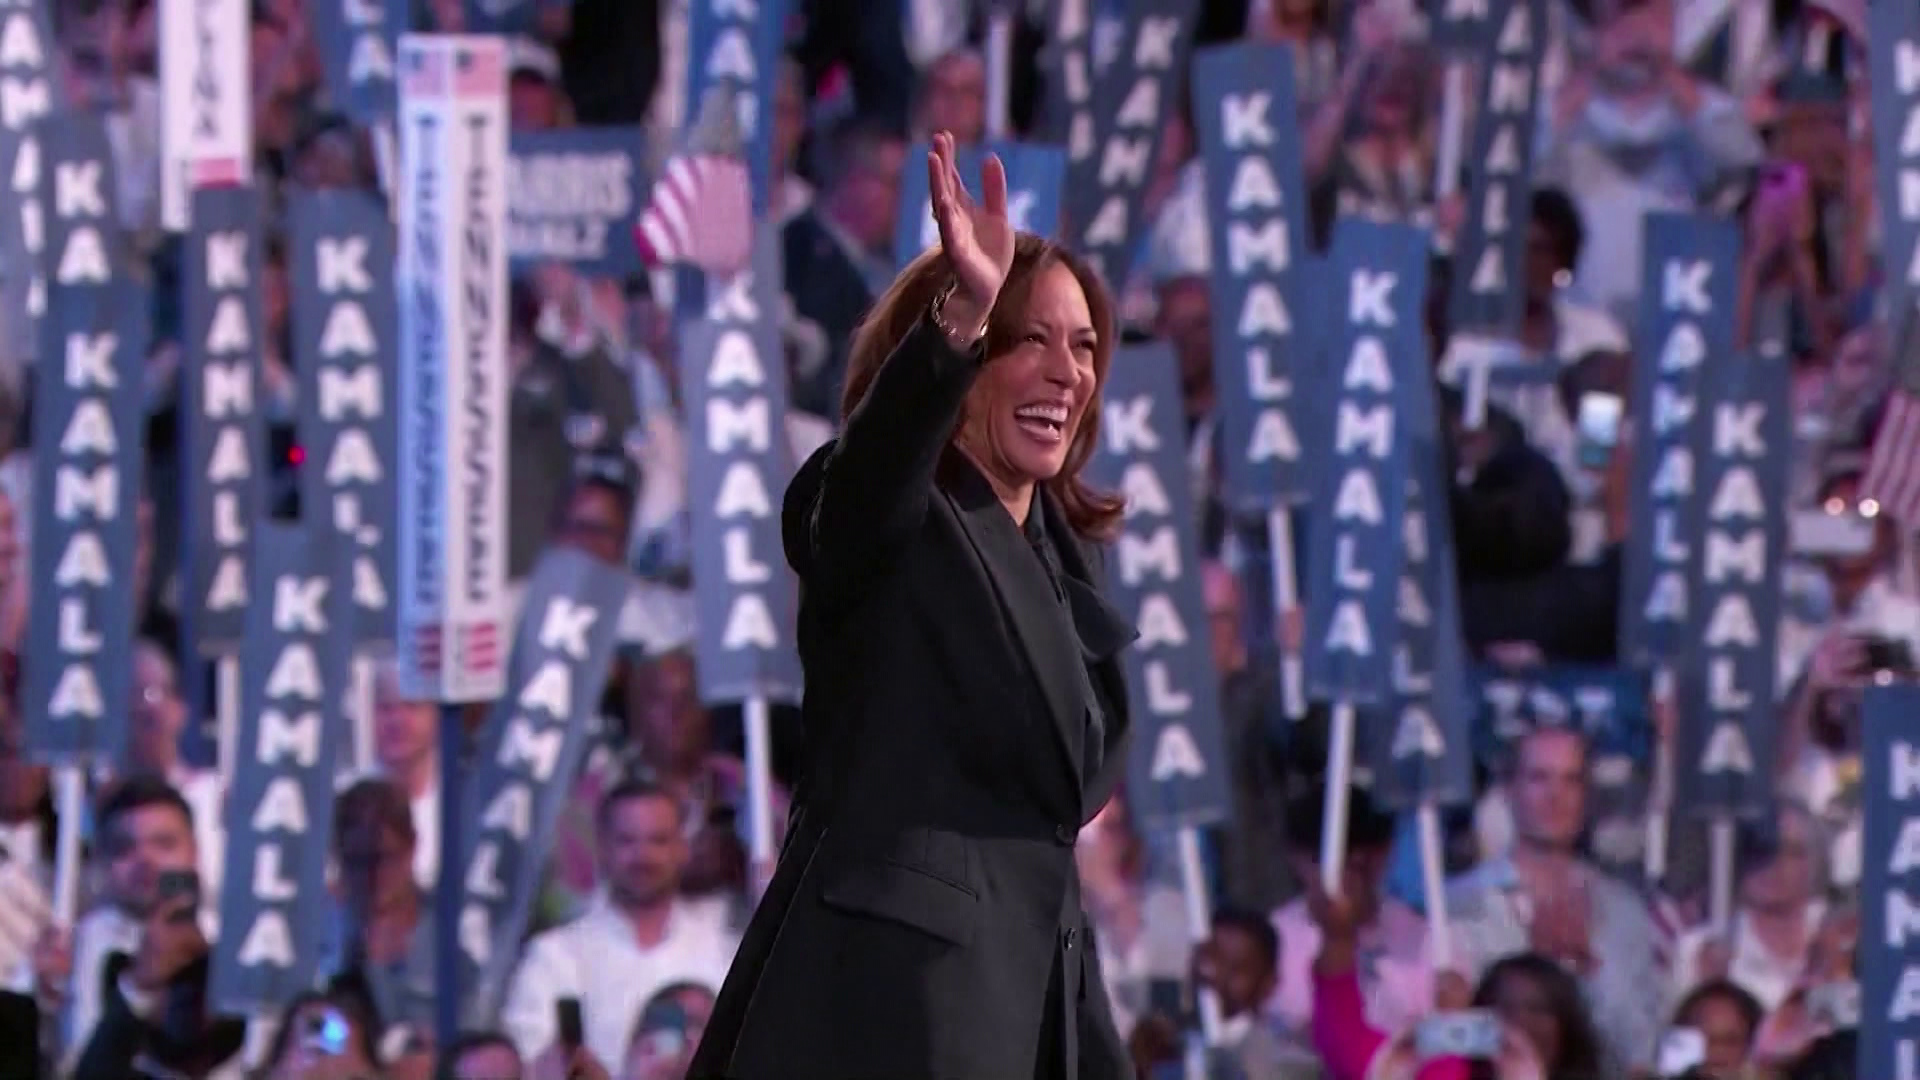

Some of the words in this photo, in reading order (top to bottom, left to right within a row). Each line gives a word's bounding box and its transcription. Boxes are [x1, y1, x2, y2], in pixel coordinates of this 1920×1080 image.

[204, 230, 253, 610] KAMALA
[315, 234, 388, 610] KAMALA
[707, 268, 778, 649] KAMALA
[1222, 91, 1300, 463] KAMALA
[1321, 267, 1398, 656] KAMALA
[48, 331, 121, 719] KAMALA
[1107, 395, 1207, 781] KAMALA
[1702, 401, 1769, 773] KAMALA
[237, 574, 330, 967] KAMALA
[458, 596, 599, 963] KAMALA
